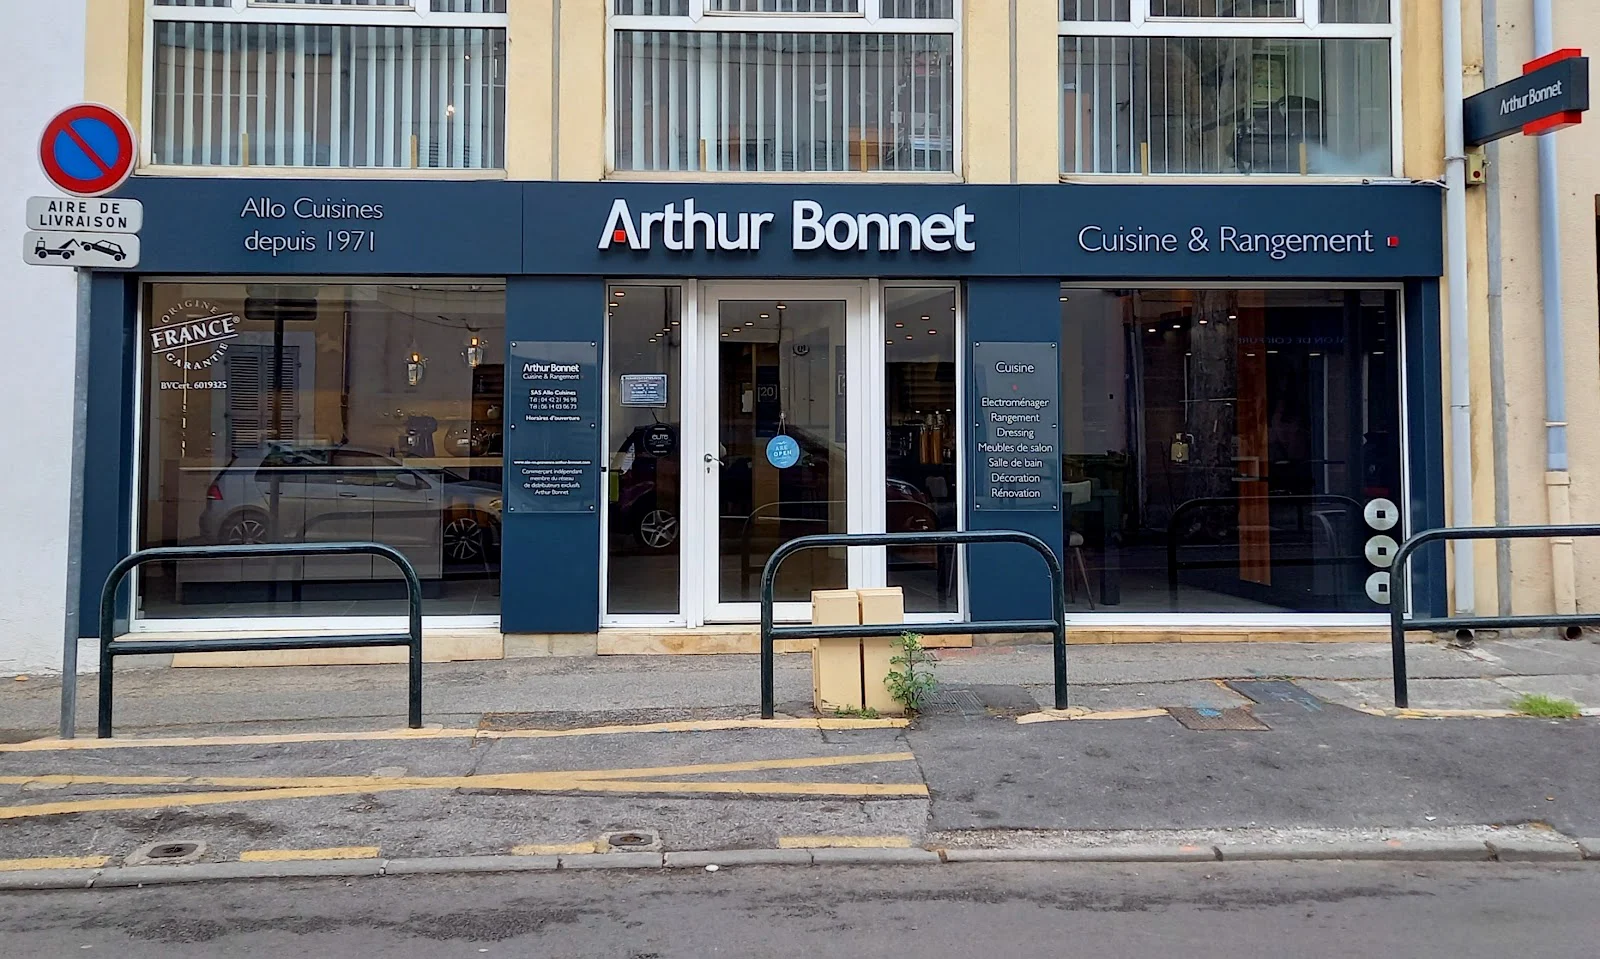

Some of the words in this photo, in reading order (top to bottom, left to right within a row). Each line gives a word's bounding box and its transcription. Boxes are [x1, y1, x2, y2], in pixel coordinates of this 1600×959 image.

[1500, 94, 1528, 116] Arthur
[1528, 80, 1562, 104] Bonnet
[48, 201, 87, 214] AIRE
[100, 201, 121, 214] DE
[240, 197, 286, 220] Allo
[293, 198, 384, 220] Cuisines
[39, 214, 128, 228] LIVRAISON
[598, 198, 775, 250] Arthur
[792, 199, 976, 252] Bonnet
[244, 230, 316, 257] depuis
[326, 230, 376, 252] 1971
[1078, 225, 1177, 252] Cuisine
[1188, 226, 1210, 252] &
[1220, 226, 1374, 260] Rangement
[162, 300, 218, 323] ORIGINE
[166, 343, 228, 370] GARANTIE
[523, 364, 550, 372] Arthur
[551, 364, 580, 372] Bonnet
[996, 362, 1034, 373] Cuisine
[194, 381, 227, 389] 6019325
[982, 397, 1049, 409] Electroménager
[990, 412, 1040, 424] Rangement
[996, 428, 1034, 439] Dressing
[978, 443, 1015, 452] Meubles
[1017, 443, 1028, 452] de
[1030, 443, 1052, 452] salon
[988, 458, 1008, 467] Salle
[1011, 458, 1022, 467] de
[1024, 458, 1042, 467] bain
[991, 473, 1040, 482] Décoration
[991, 488, 1040, 498] Rénovation
